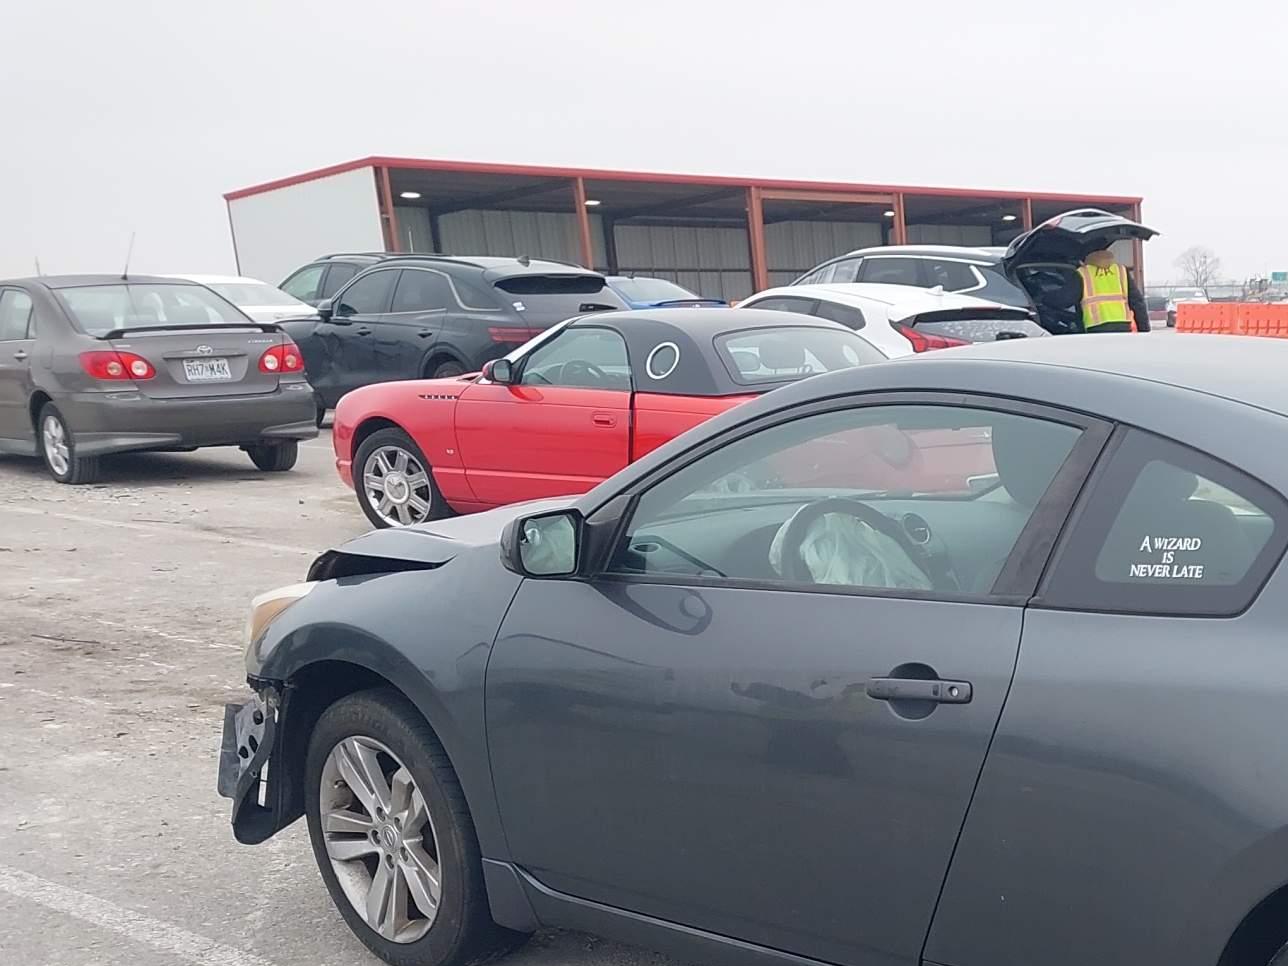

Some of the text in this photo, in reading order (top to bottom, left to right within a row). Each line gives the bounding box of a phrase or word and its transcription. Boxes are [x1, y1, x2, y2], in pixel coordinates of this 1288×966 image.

[1140, 535, 1201, 552] A WIZARD
[1162, 551, 1174, 563] IS
[1129, 564, 1203, 578] NEVER LATE
